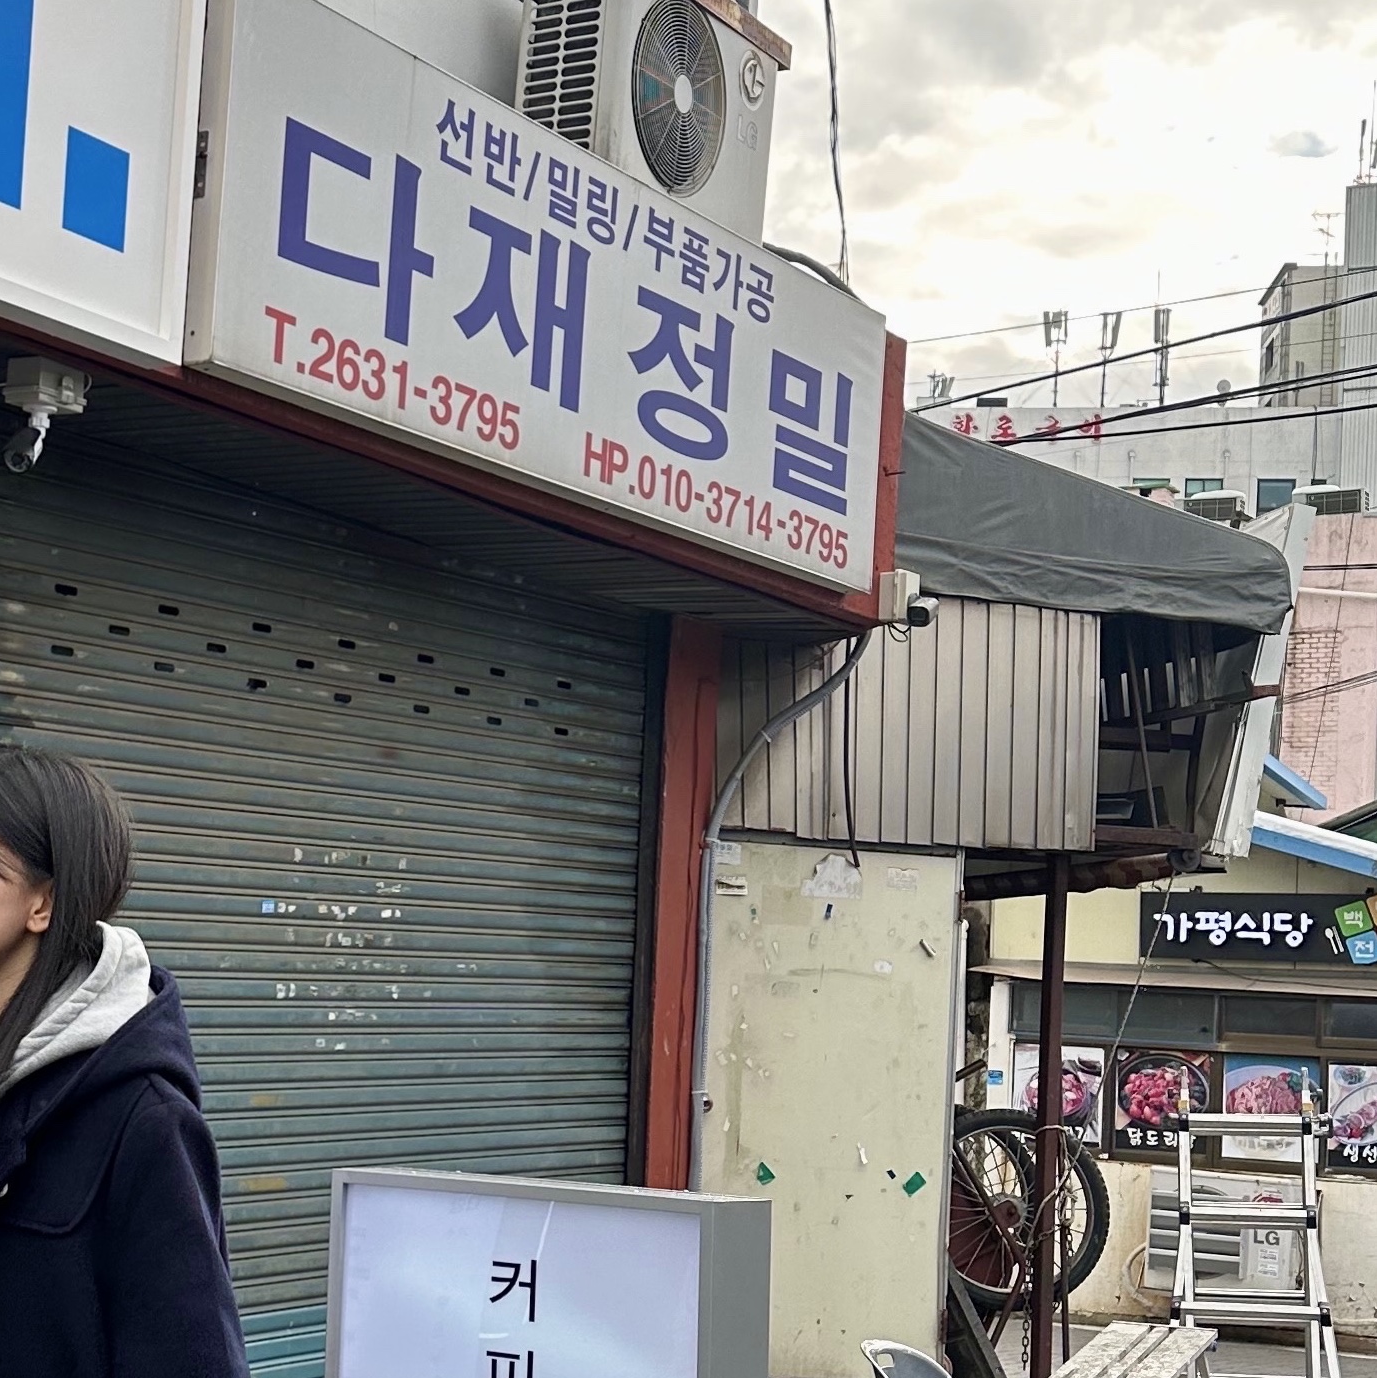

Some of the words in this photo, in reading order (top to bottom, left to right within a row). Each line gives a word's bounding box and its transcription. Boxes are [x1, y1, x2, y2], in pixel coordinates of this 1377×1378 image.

[736, 114, 759, 152] LG
[435, 98, 776, 325] 선반/밀링/부품가공
[277, 115, 854, 517] 다재정밀
[265, 306, 521, 451] T.2631-3795
[583, 431, 850, 570] HP.010-3714-3795
[1153, 910, 1314, 948] 가평식당
[1126, 1127, 1198, 1150] 닭도리
[1253, 1230, 1281, 1247] LG
